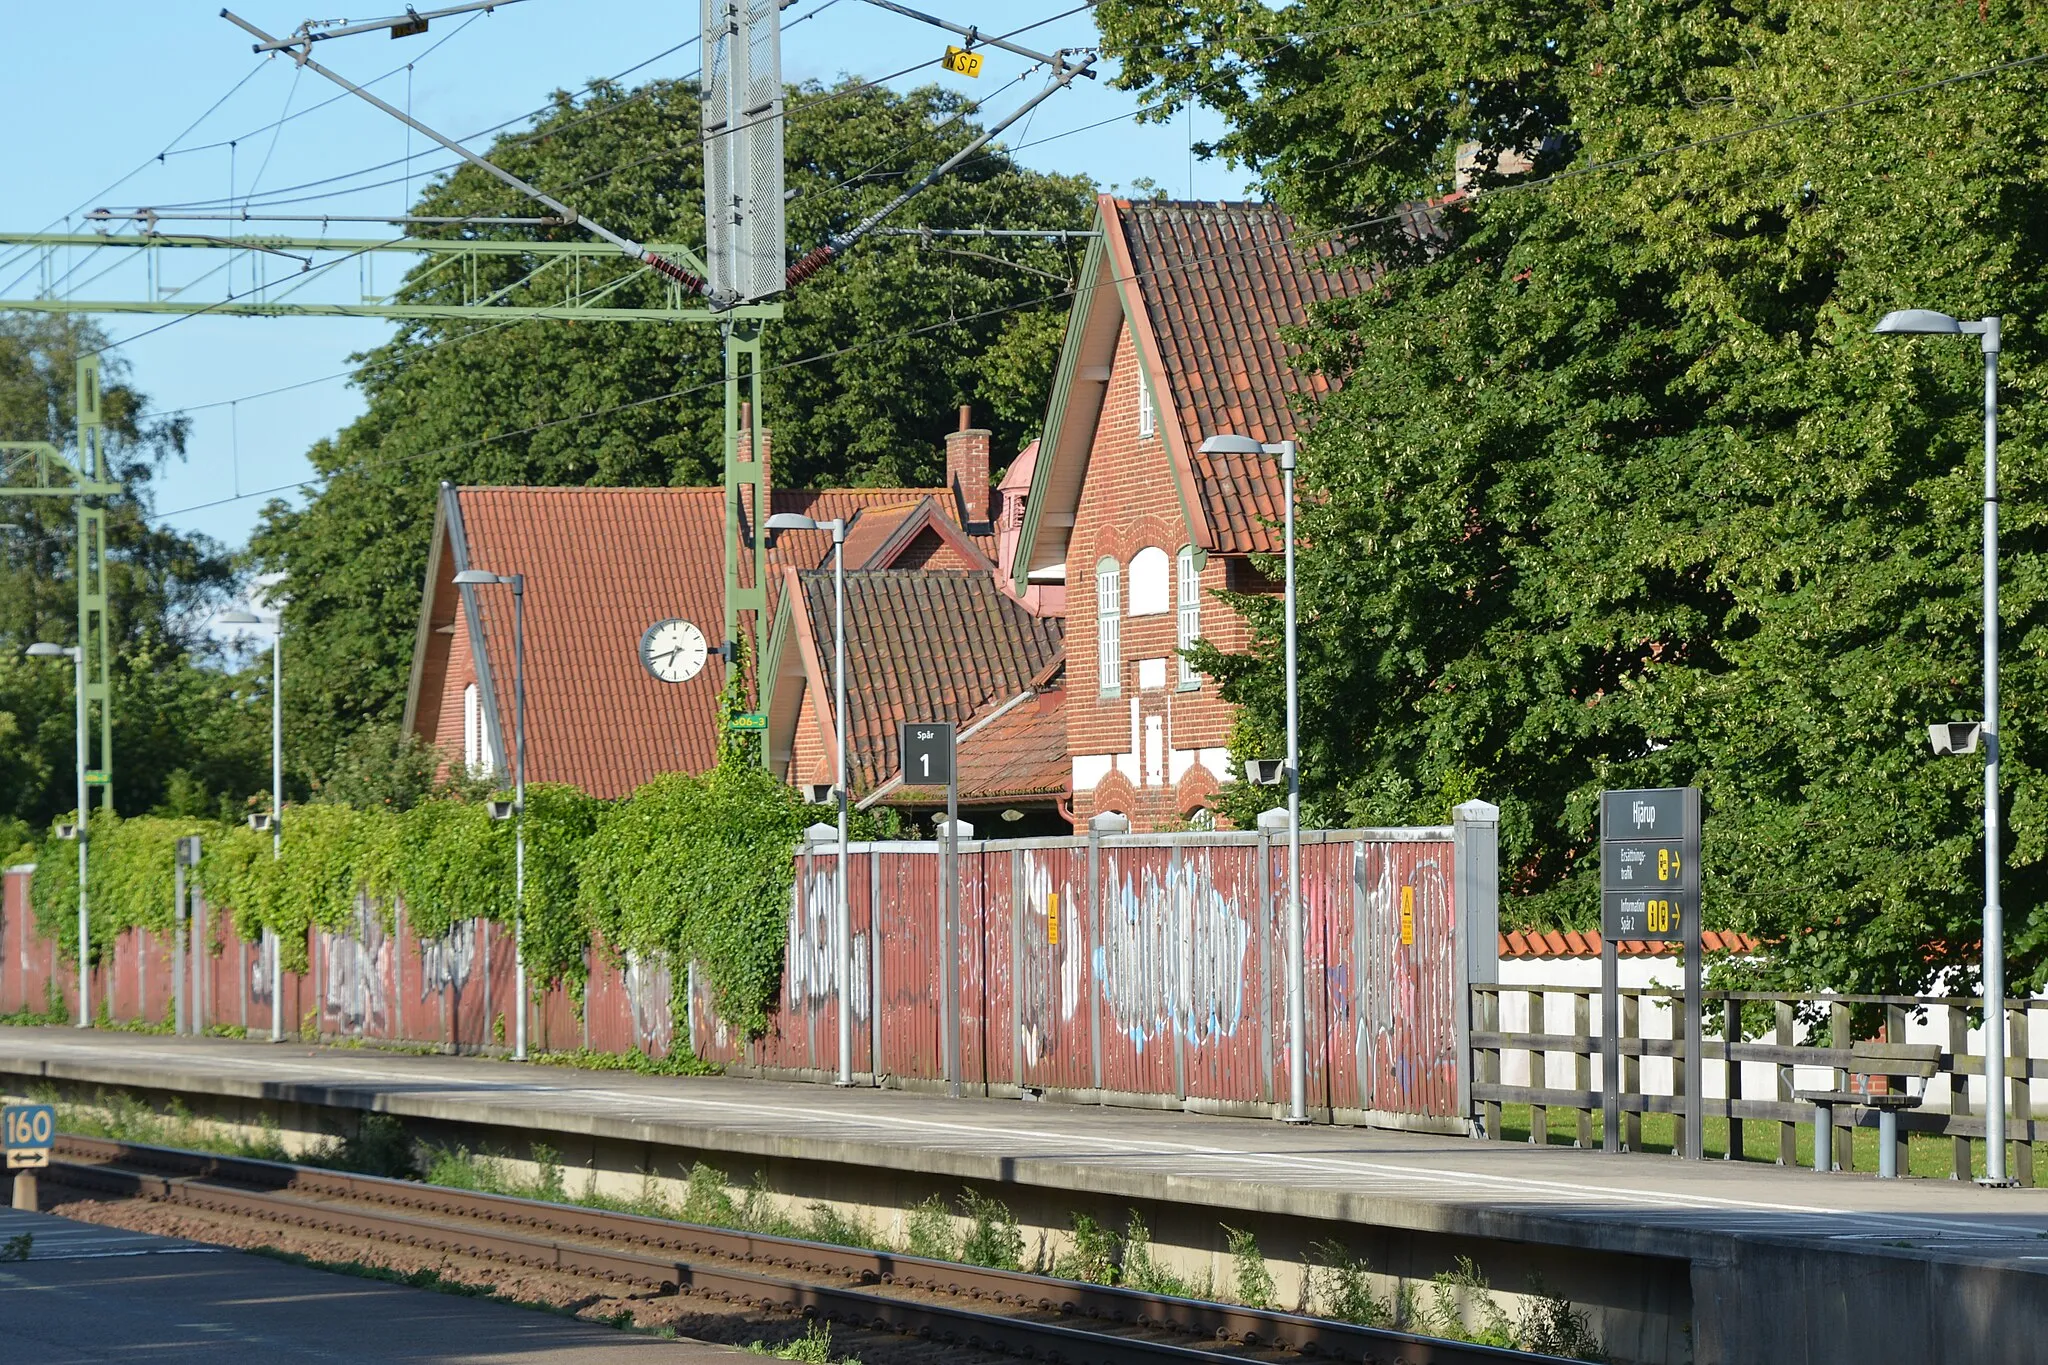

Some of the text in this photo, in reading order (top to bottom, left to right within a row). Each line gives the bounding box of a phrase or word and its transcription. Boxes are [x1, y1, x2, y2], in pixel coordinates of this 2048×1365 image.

[946, 52, 978, 73] NSP
[917, 731, 934, 741] Spår
[919, 753, 930, 777] 1
[1632, 800, 1656, 829] Hjärup
[1620, 866, 1633, 880] trafik
[1620, 897, 1645, 912] Information
[1620, 915, 1631, 934] Spår
[6, 1110, 51, 1143] 160
